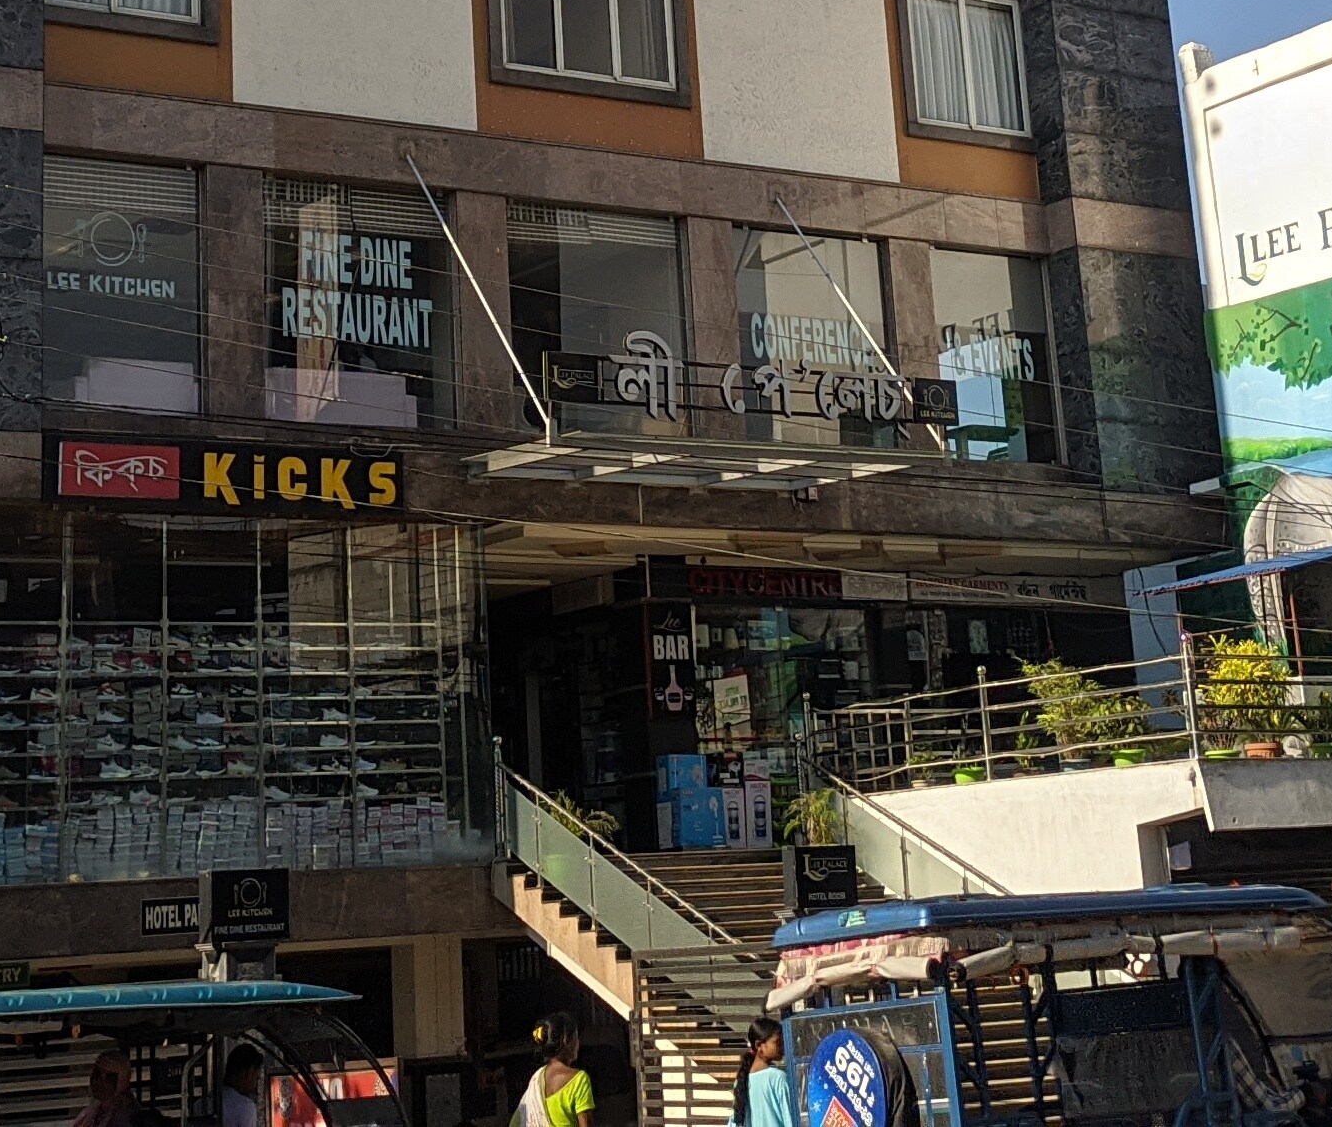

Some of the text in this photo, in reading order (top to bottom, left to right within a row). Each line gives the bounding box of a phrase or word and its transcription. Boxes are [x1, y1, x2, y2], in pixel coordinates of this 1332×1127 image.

[302, 231, 413, 290] FINE DINE
[47, 272, 175, 299] LEE KITCHEN
[282, 287, 433, 348] RESTAURANT
[751, 312, 875, 369] CONFERENCE
[971, 336, 1035, 381] EVENTS
[653, 635, 690, 660] BAR
[145, 903, 200, 929] HOTEL PA
